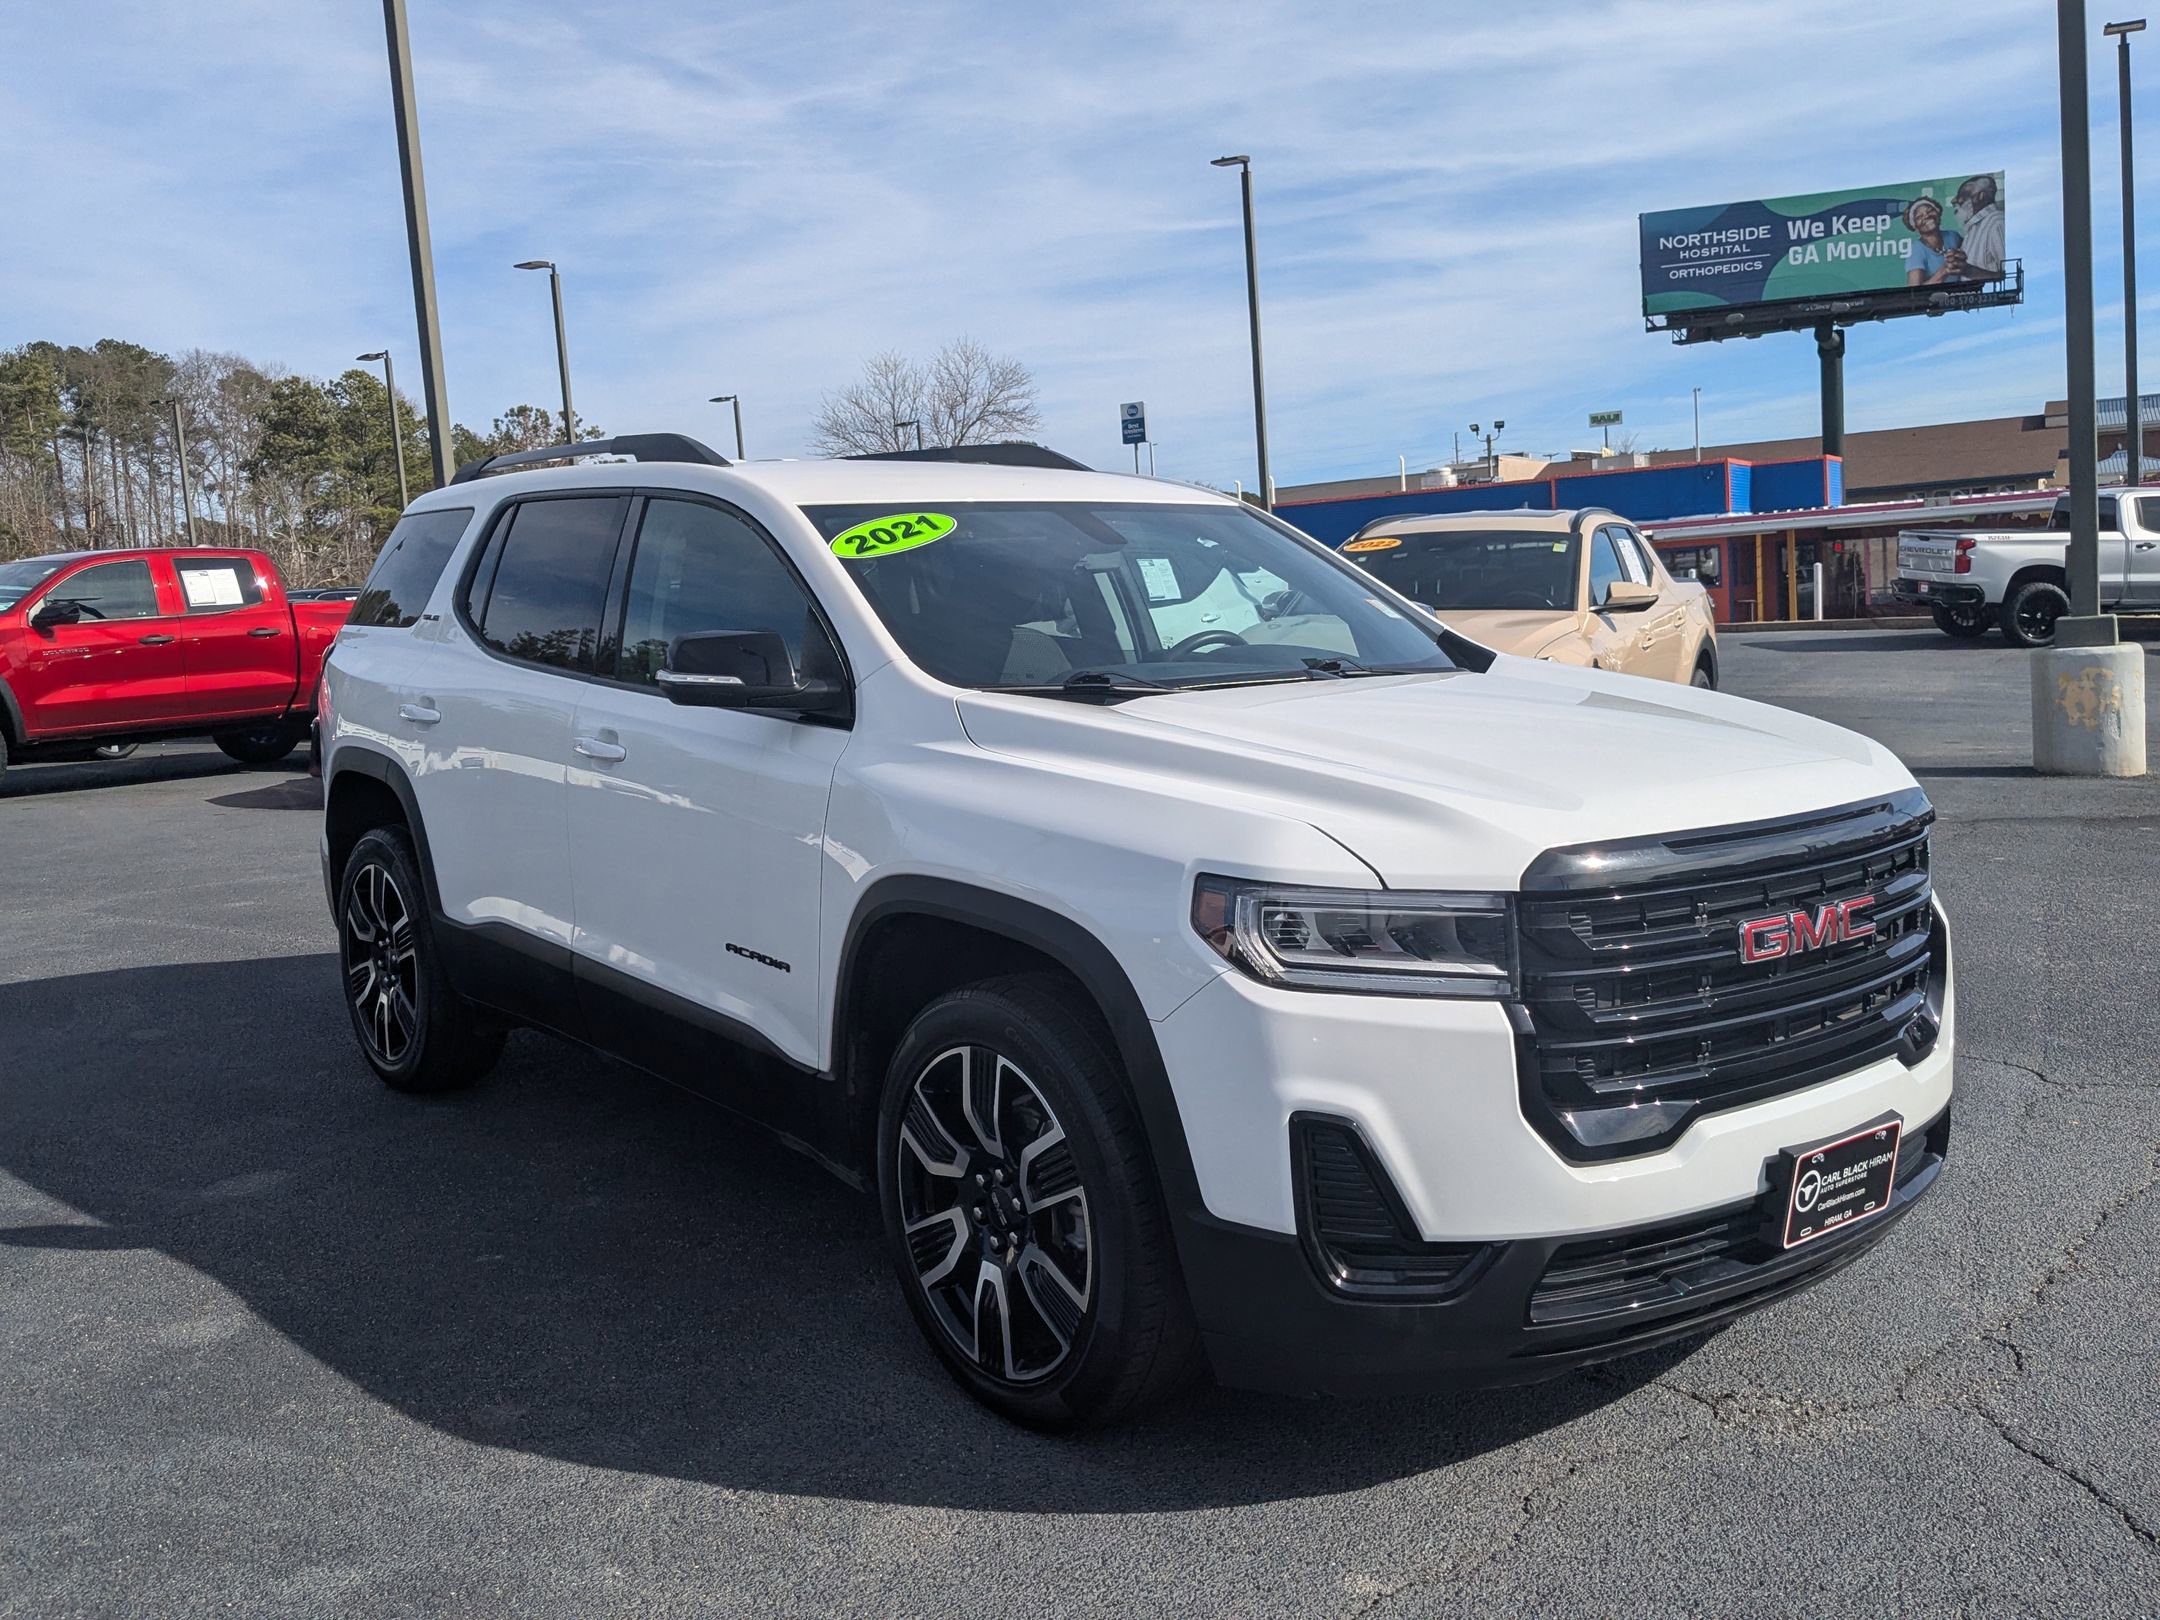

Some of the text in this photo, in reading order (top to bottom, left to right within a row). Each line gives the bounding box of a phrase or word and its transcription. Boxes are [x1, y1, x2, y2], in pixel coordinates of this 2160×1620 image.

[1659, 225, 1772, 250] NORTHSIDE
[1786, 214, 1891, 240] We Keep
[1680, 243, 1751, 259] HOSPITAL
[1788, 236, 1912, 265] GA Moving
[1669, 261, 1763, 279] ORTHOPEDICS
[844, 515, 942, 555] 2021
[1349, 540, 1399, 550] 2022
[1899, 544, 1950, 555] CHEVROLET
[1737, 895, 1877, 965] GMC
[725, 942, 791, 973] ACADIA
[1821, 1151, 1894, 1186] CARL BLACK HIRAM
[1820, 1171, 1868, 1193] AUTO SUPERSTORE
[1844, 1209, 1852, 1219] GA
